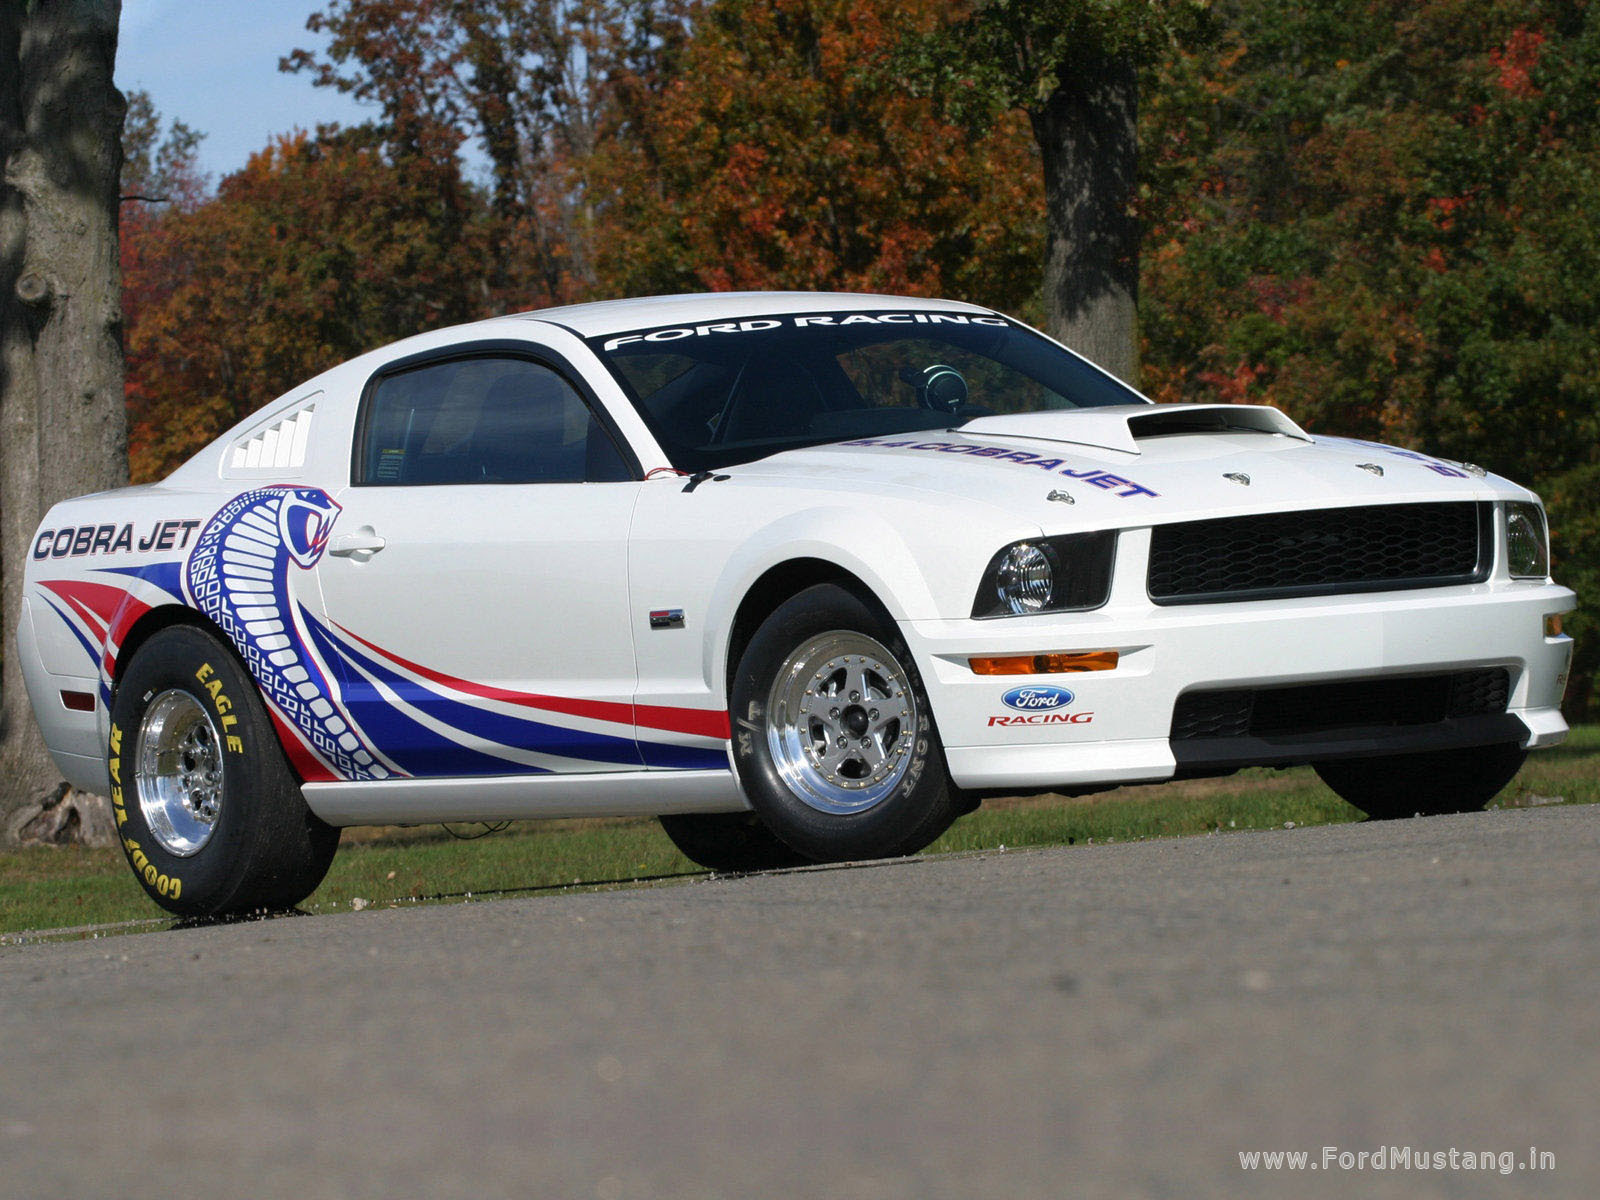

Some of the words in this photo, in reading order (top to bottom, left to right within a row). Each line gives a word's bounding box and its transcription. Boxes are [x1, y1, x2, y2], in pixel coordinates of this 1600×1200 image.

[604, 320, 782, 351] FORD
[794, 314, 1010, 328] RACING
[909, 442, 1067, 471] COBRA
[1058, 468, 1161, 500] JET
[33, 522, 134, 561] COBRA
[137, 519, 202, 551] JET
[195, 662, 243, 754] EAGLE
[1015, 689, 1060, 708] Ford
[987, 712, 1095, 727] RACING
